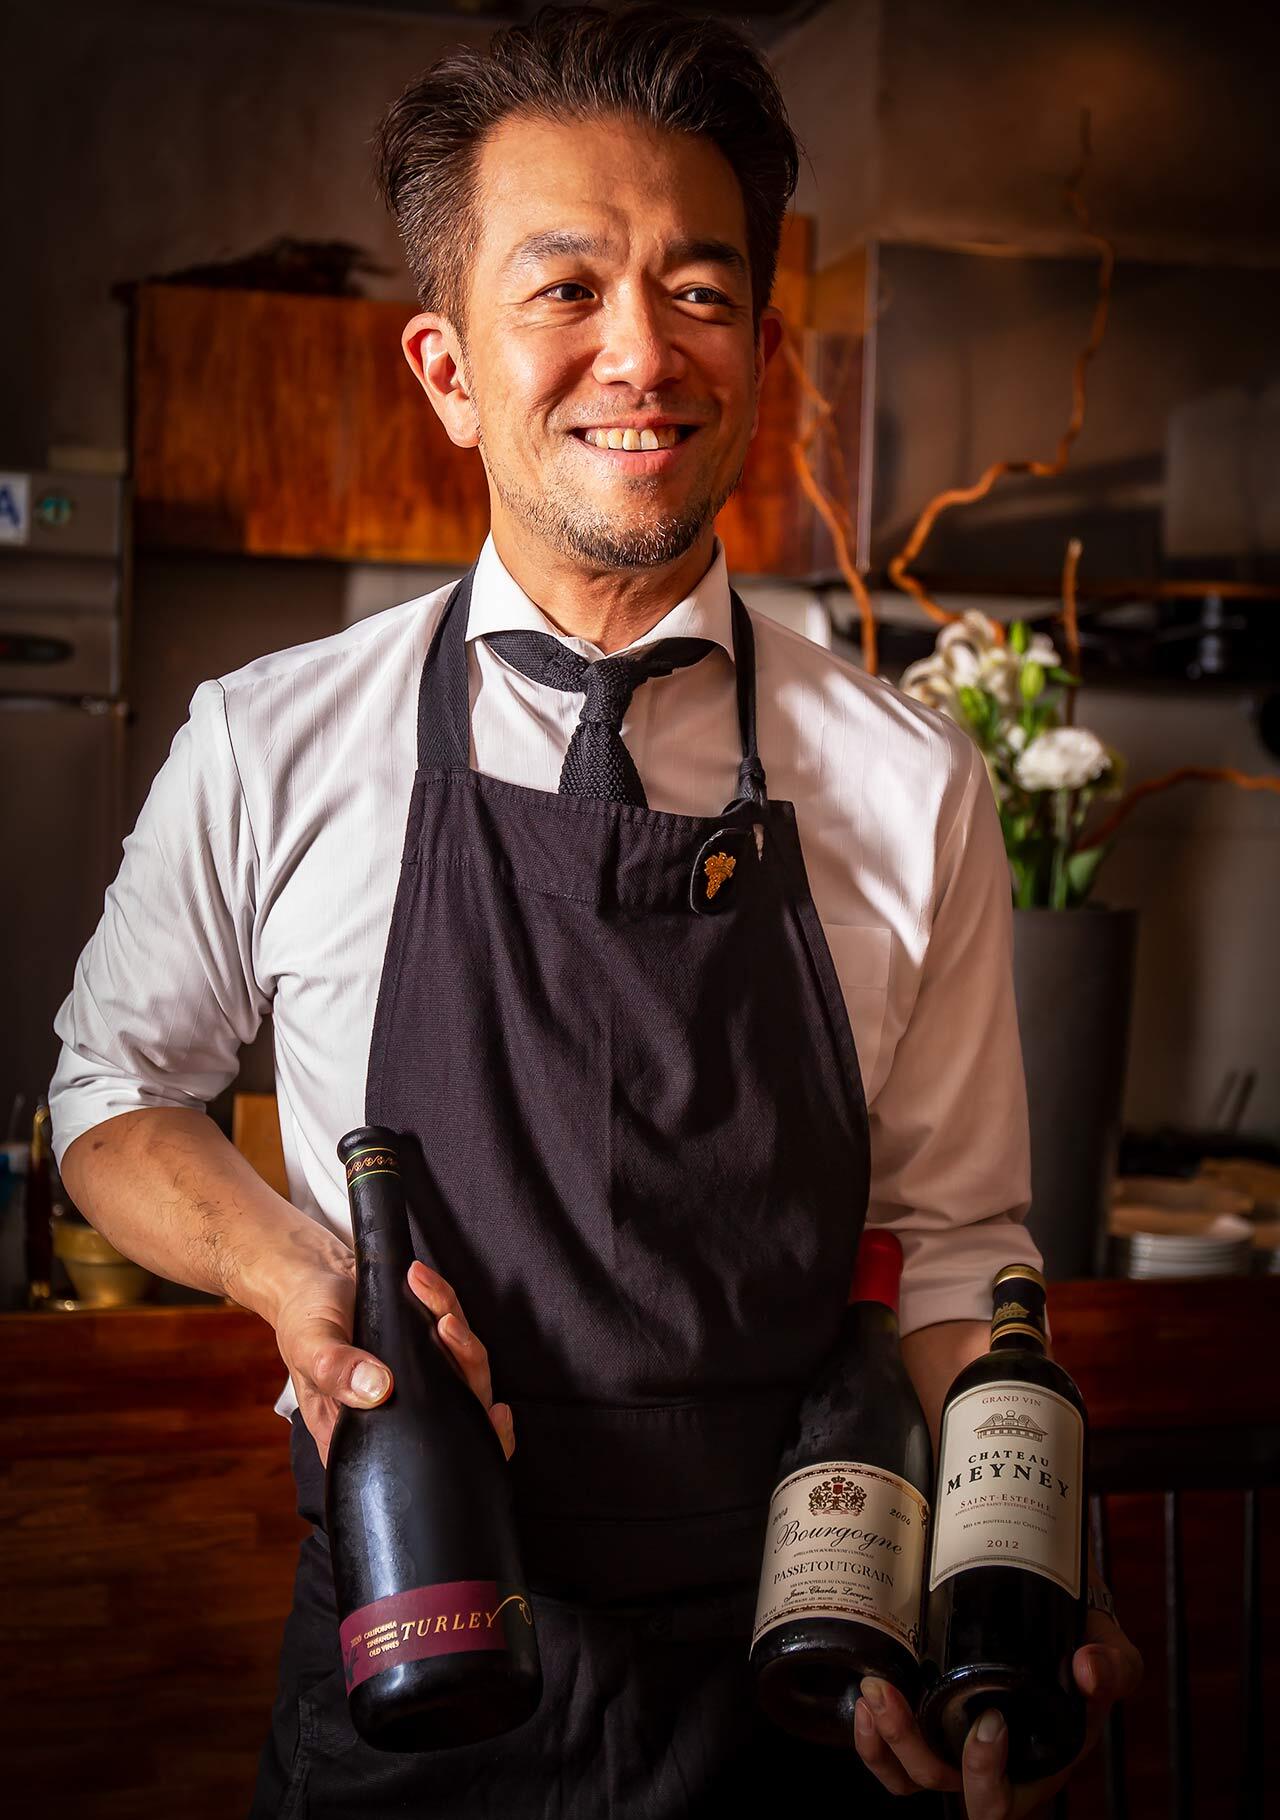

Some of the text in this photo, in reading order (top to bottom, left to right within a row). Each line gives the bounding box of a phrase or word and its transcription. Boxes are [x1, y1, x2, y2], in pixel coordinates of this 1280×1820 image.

[982, 1395, 1042, 1407] GRAND VIN
[968, 1450, 1049, 1467] CHATEAU
[946, 1463, 1070, 1498] MEYNEY
[773, 1519, 904, 1555] Bourgogne
[986, 1539, 1020, 1550] 2012
[772, 1560, 895, 1588] PASSETOUTGRAIN
[400, 1610, 496, 1642] TURLEY
[368, 1647, 382, 1658] OLD
